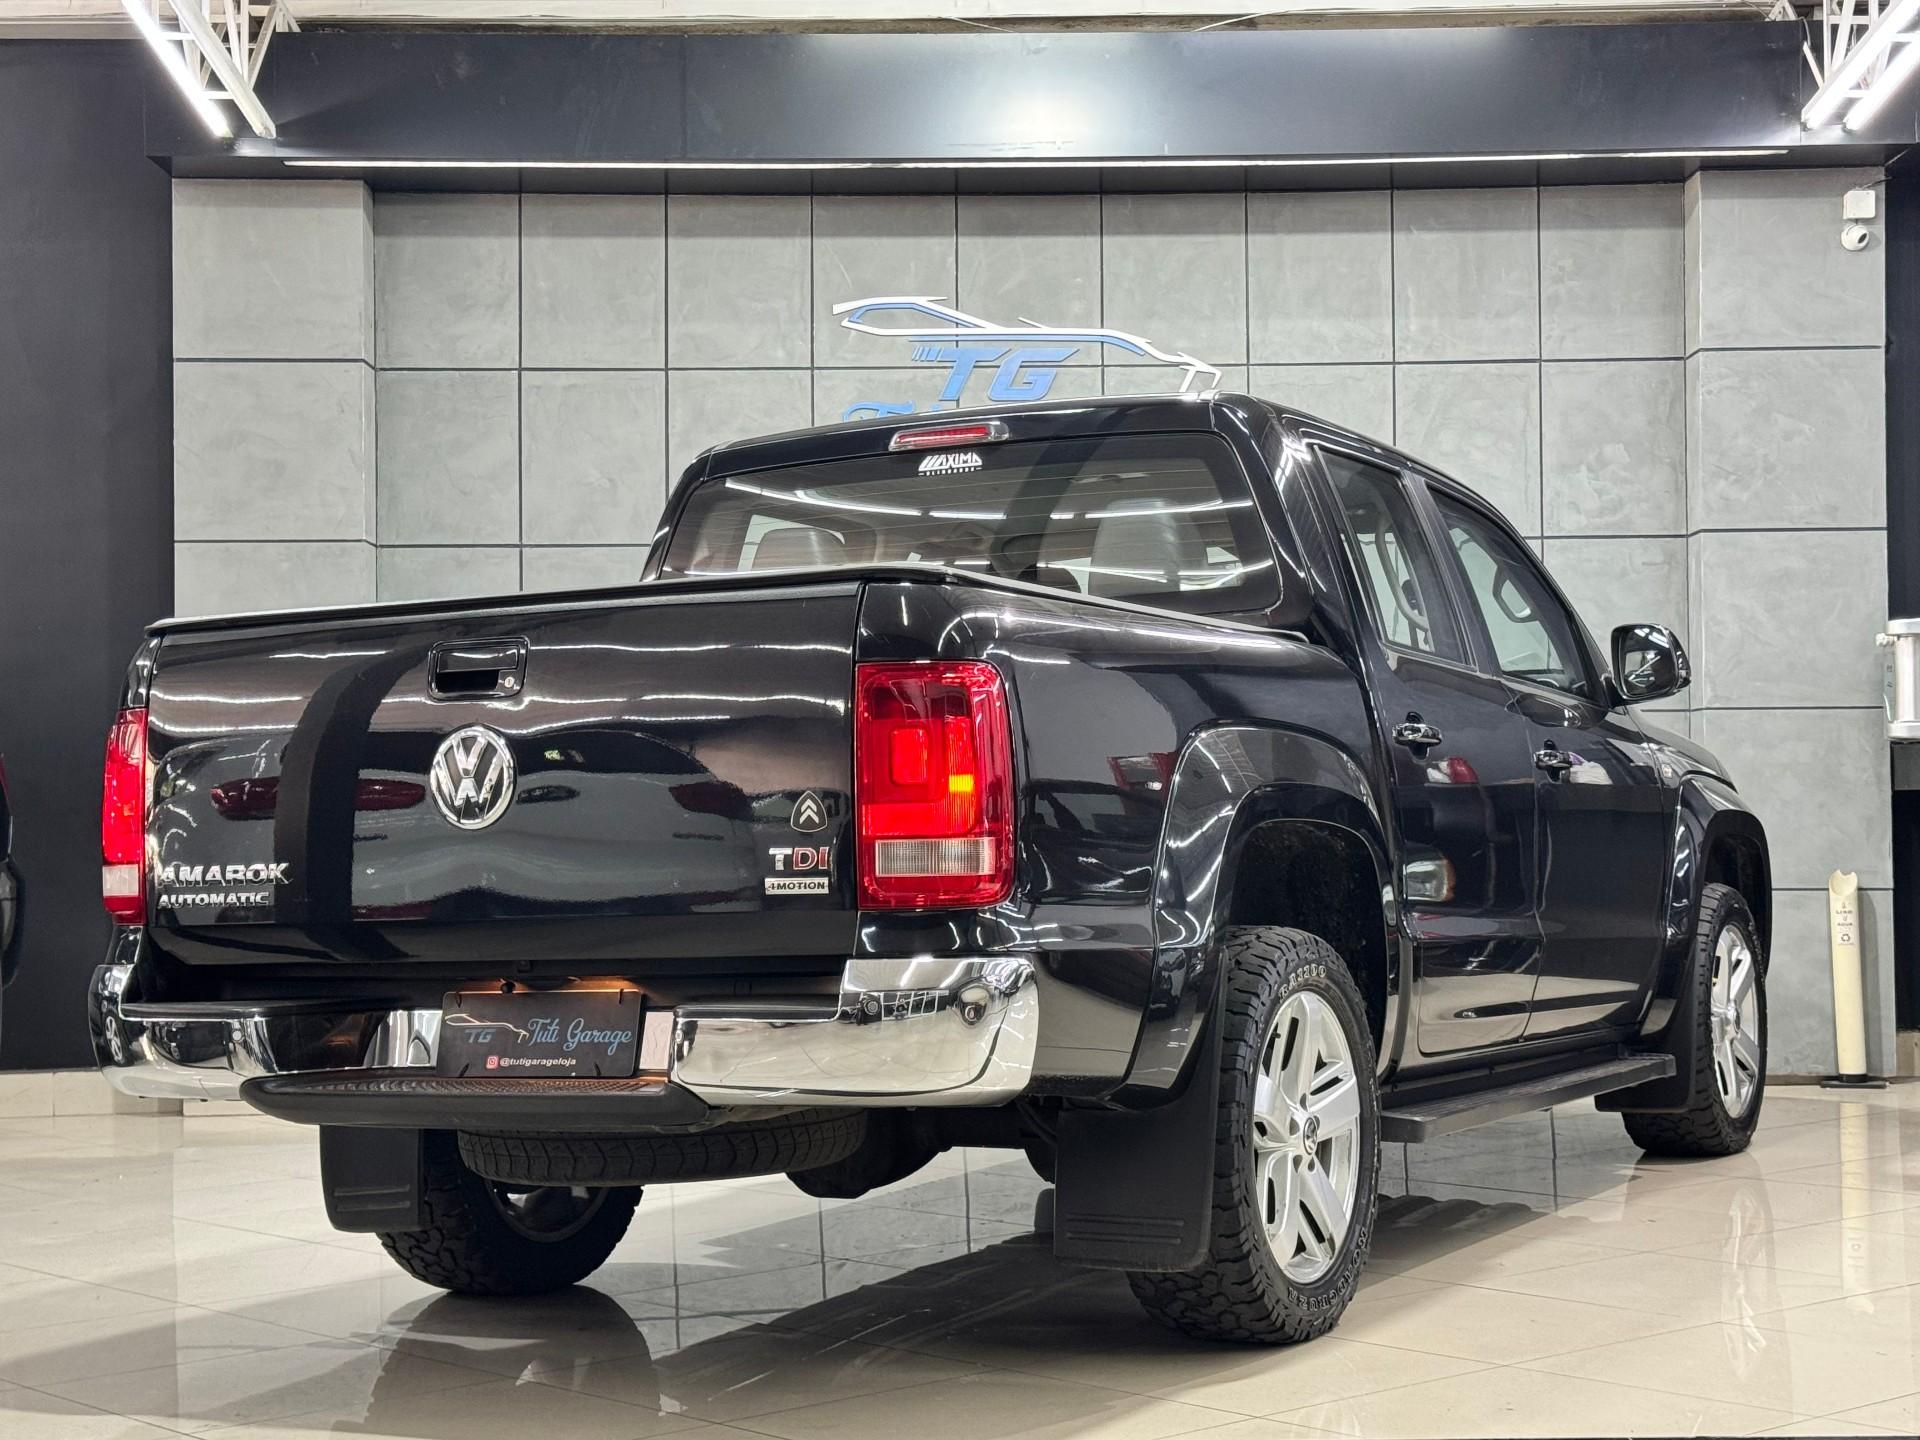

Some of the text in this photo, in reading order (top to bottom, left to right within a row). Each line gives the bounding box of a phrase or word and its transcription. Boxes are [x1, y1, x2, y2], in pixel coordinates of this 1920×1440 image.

[936, 346, 1080, 402] TG
[768, 846, 830, 871] TDI
[158, 862, 293, 888] AMAROK
[767, 881, 826, 891] 4MOTION
[157, 891, 270, 910] AUTOMATIC
[464, 1028, 496, 1044] TG
[527, 1018, 633, 1056] Tuti Garage
[499, 1057, 577, 1067] @tutigarageloja
